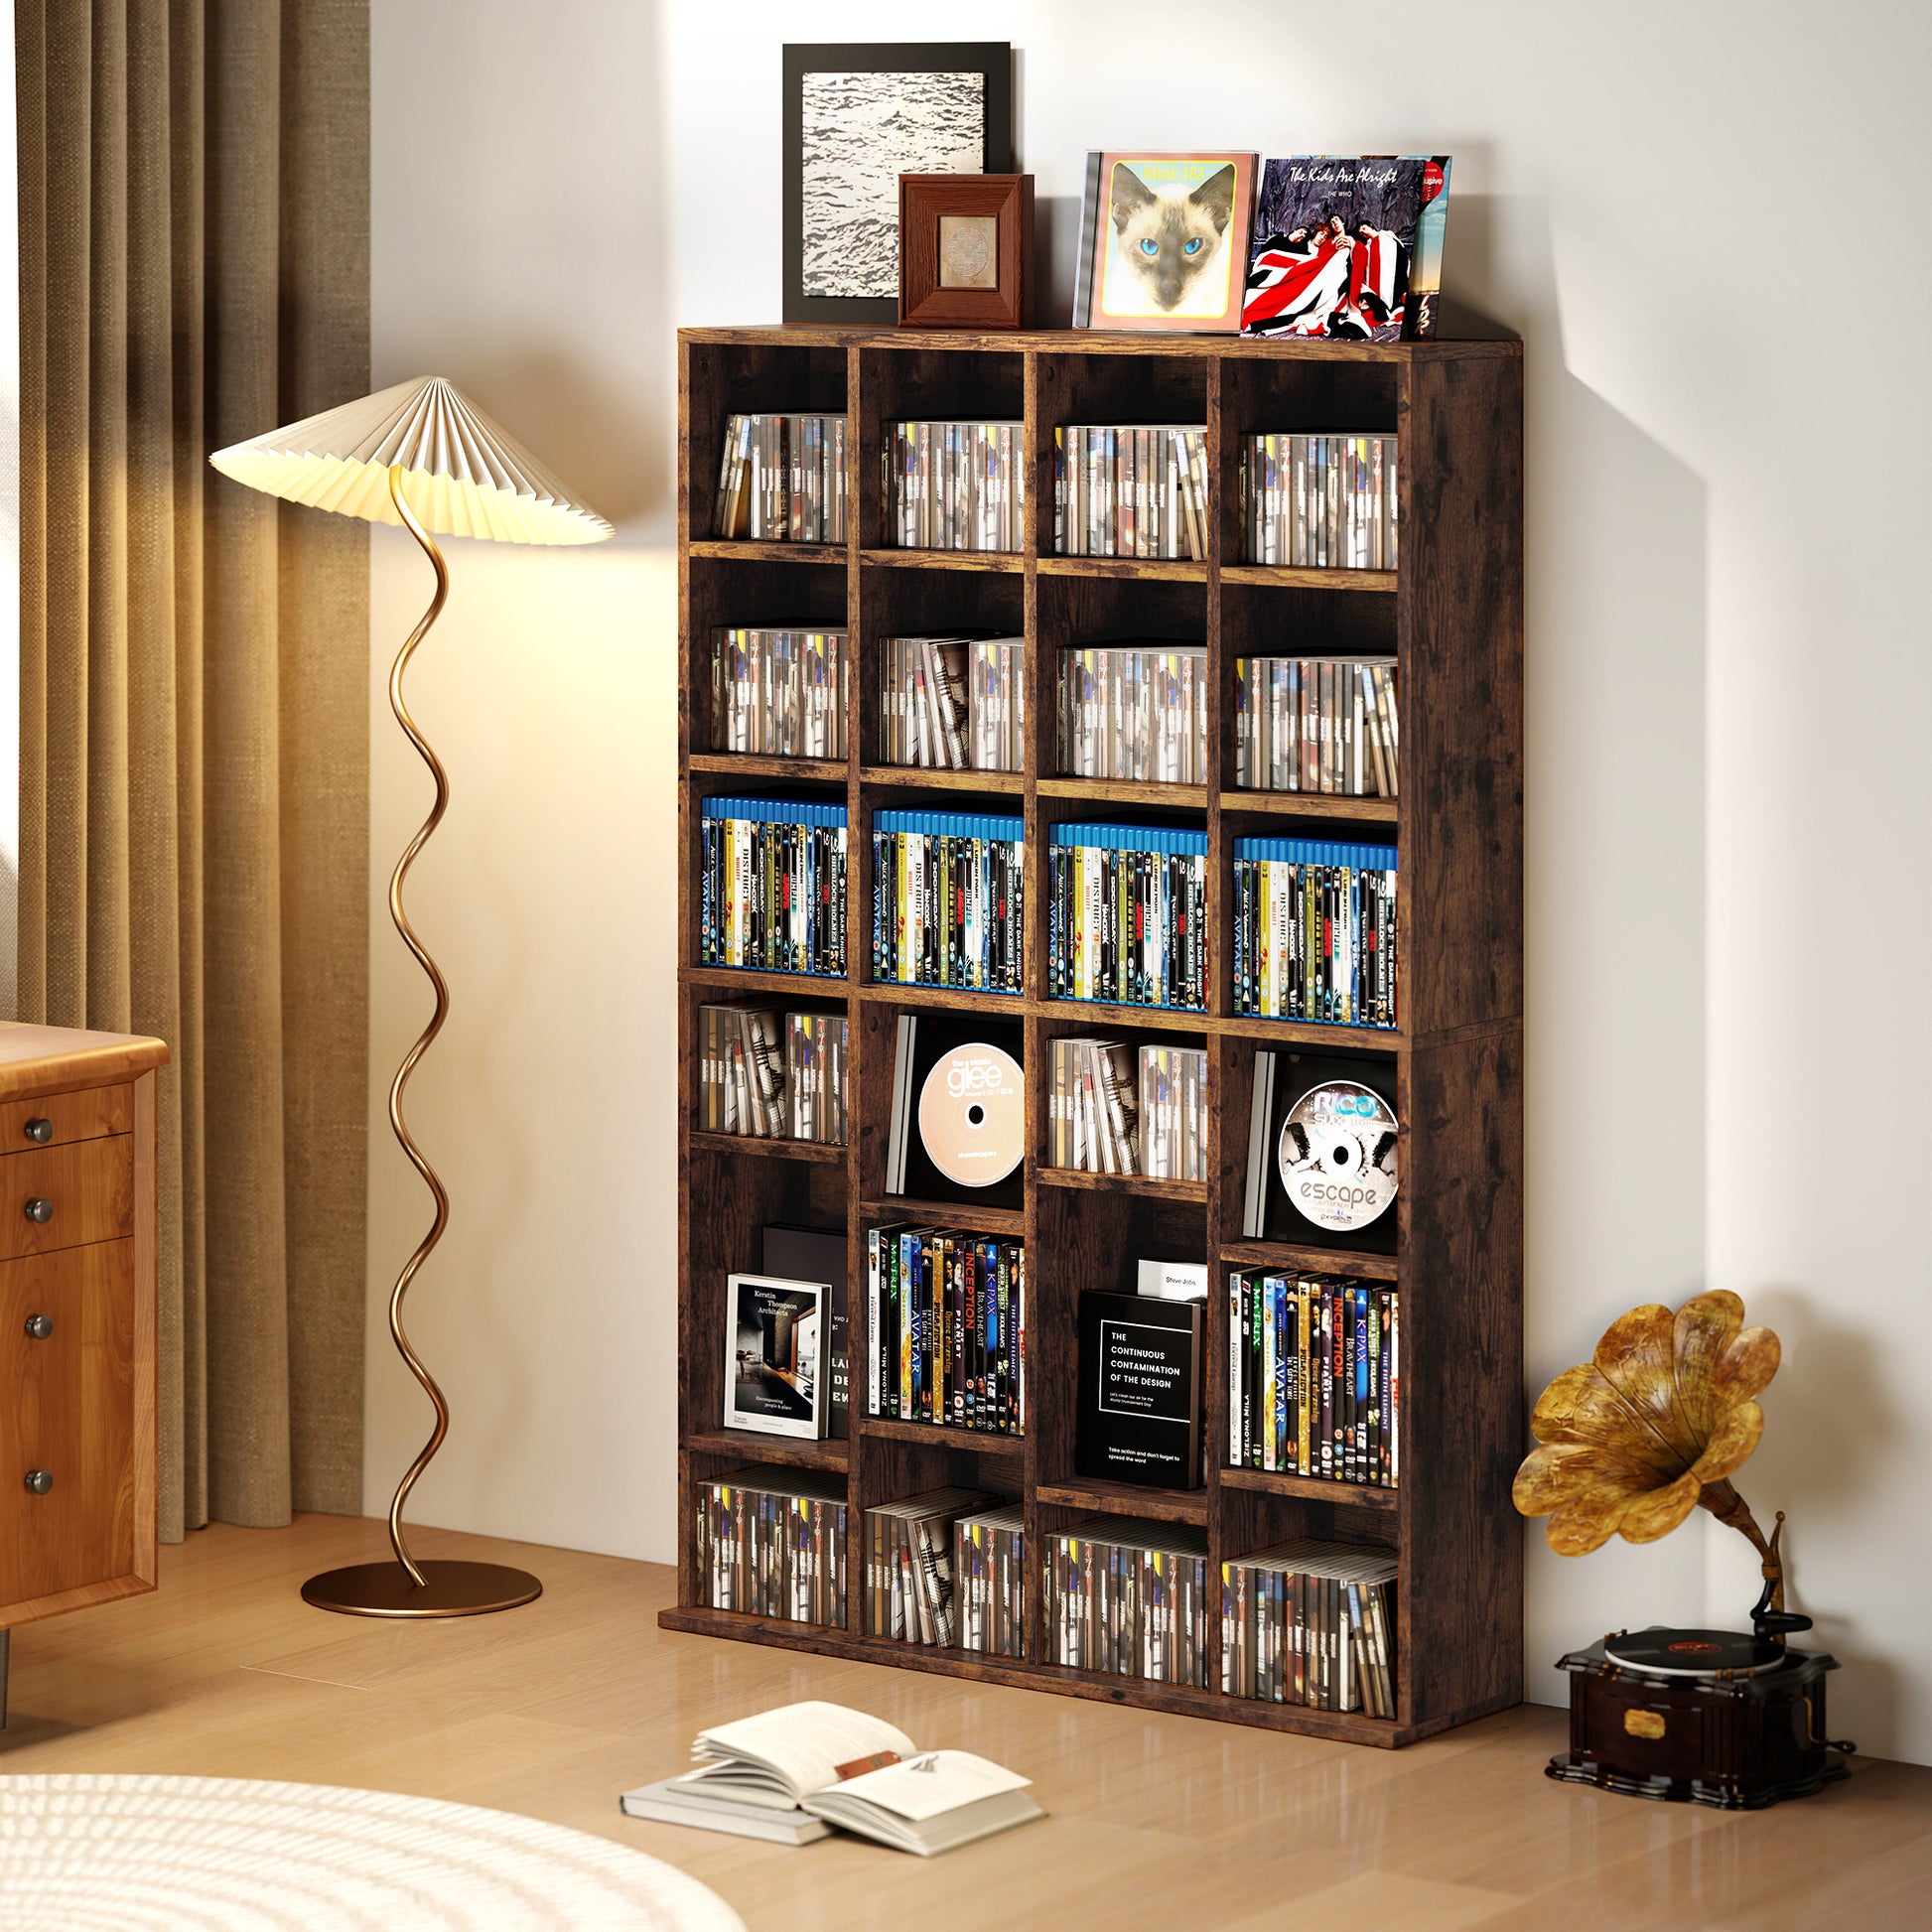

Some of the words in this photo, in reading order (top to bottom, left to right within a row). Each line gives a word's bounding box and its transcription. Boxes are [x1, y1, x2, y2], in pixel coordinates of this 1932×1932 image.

[1144, 165, 1177, 180] blink
[1291, 167, 1306, 183] The
[1308, 167, 1334, 182] Kids
[1335, 167, 1355, 184] Are
[1355, 167, 1397, 189] Alright
[947, 1060, 1003, 1098] glee
[1301, 1182, 1377, 1209] escape
[965, 1252, 974, 1329] INCEPTION
[987, 1274, 996, 1316] K-PAX
[759, 1307, 788, 1316] Architects
[766, 1301, 797, 1310] Thompson
[911, 1311, 920, 1374] AVATAR
[1112, 1332, 1126, 1341] THE
[1333, 1298, 1343, 1377] INCEPTION
[1357, 1319, 1366, 1363] K-PAX
[1111, 1346, 1166, 1360] CONTINUOUS
[1110, 1360, 1179, 1376] CONTAMINATION
[1124, 1375, 1138, 1384] THE
[1142, 1378, 1172, 1388] DESIGN
[1276, 1357, 1285, 1424] AVATAR
